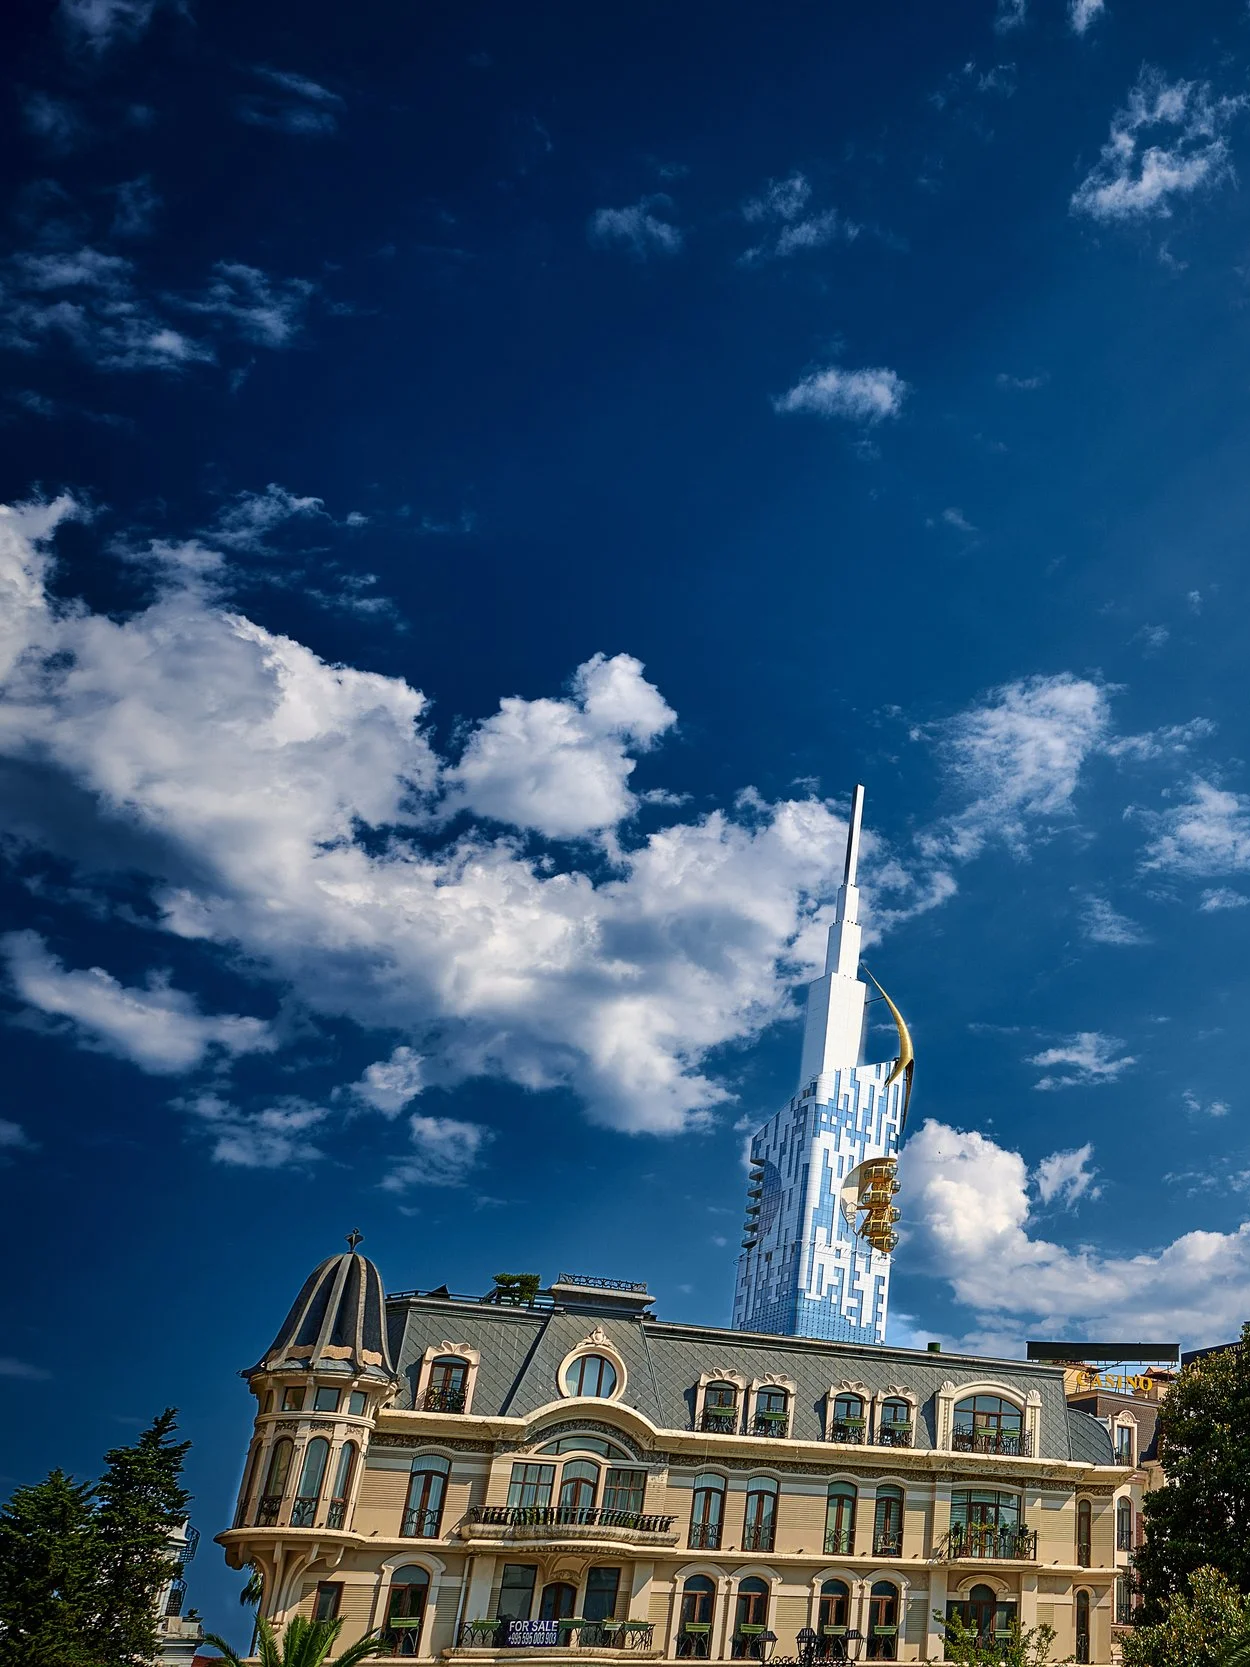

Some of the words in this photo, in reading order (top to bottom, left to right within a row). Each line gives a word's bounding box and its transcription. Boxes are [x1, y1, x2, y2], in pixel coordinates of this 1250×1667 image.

[1076, 1371, 1153, 1391] CASINO
[509, 1620, 529, 1631] FOR
[531, 1620, 559, 1631] SALE
